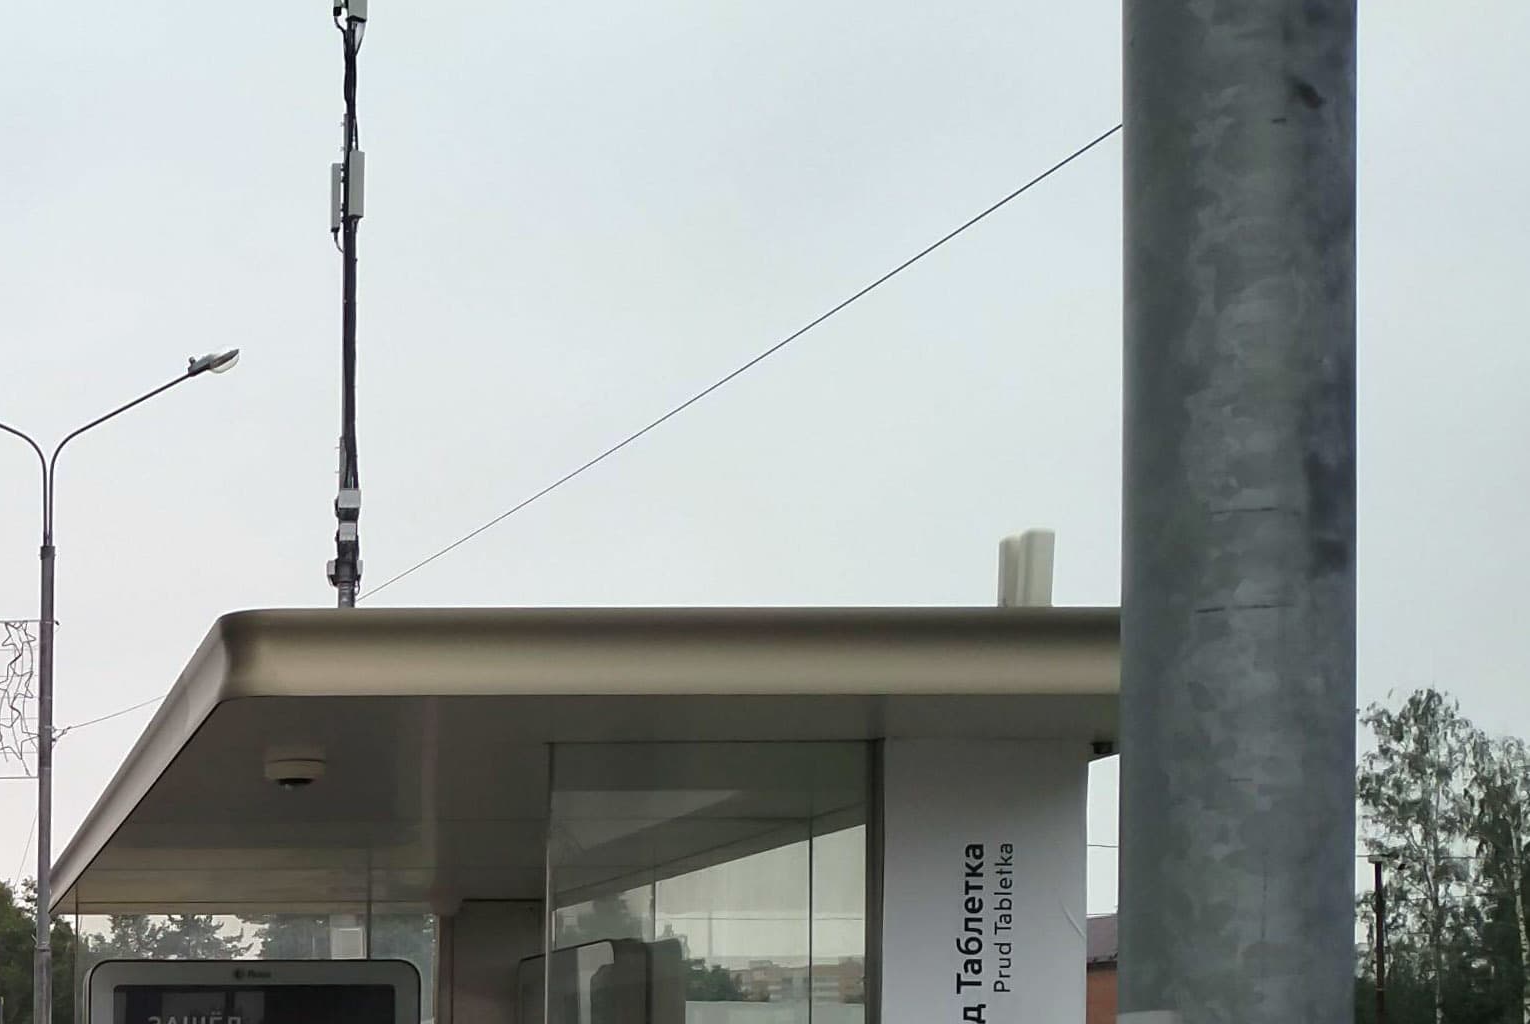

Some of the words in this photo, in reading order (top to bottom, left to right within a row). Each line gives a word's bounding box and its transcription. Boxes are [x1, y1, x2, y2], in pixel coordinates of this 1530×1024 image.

[956, 843, 984, 994] Таблетка
[994, 842, 1013, 935] Tabletka
[994, 942, 1011, 993] Prud
